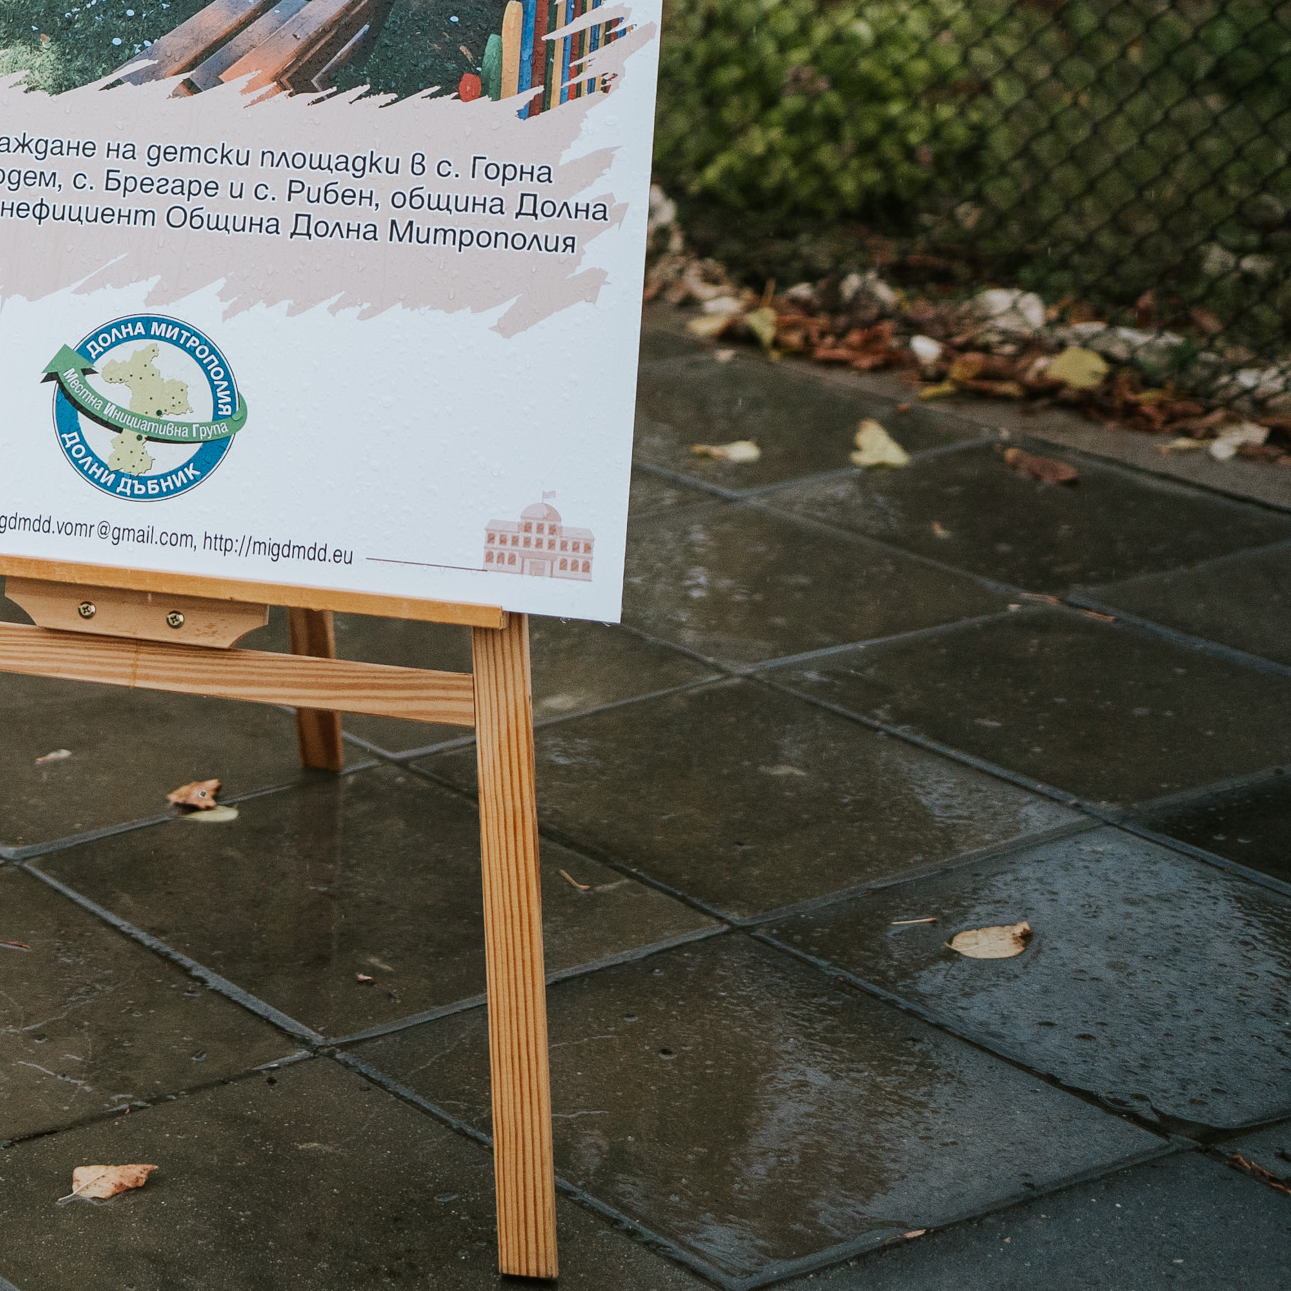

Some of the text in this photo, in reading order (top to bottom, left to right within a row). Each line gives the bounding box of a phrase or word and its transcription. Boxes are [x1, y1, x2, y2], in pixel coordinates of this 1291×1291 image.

[106, 141, 137, 160] на
[146, 143, 250, 167] детски
[259, 149, 400, 178] площадки
[411, 152, 426, 176] в
[436, 160, 461, 179] с.
[470, 156, 553, 187] Горна
[72, 174, 95, 191] с.
[104, 169, 219, 202] Брегаре
[229, 182, 244, 199] и
[253, 184, 277, 202] с.
[287, 179, 380, 210] Рибен,
[390, 186, 505, 217] община
[515, 193, 609, 222] Долна
[165, 205, 281, 234] Община
[290, 212, 379, 242] Долна
[388, 219, 577, 254] Митрополия
[86, 321, 232, 416] ДОЛНА МИТРОПОЛИЯ
[63, 367, 229, 440] Местна Инициативна Група
[61, 431, 202, 496] ДОЛНИ ДЪБНИК
[203, 531, 354, 565] http://migdmdd.eu
